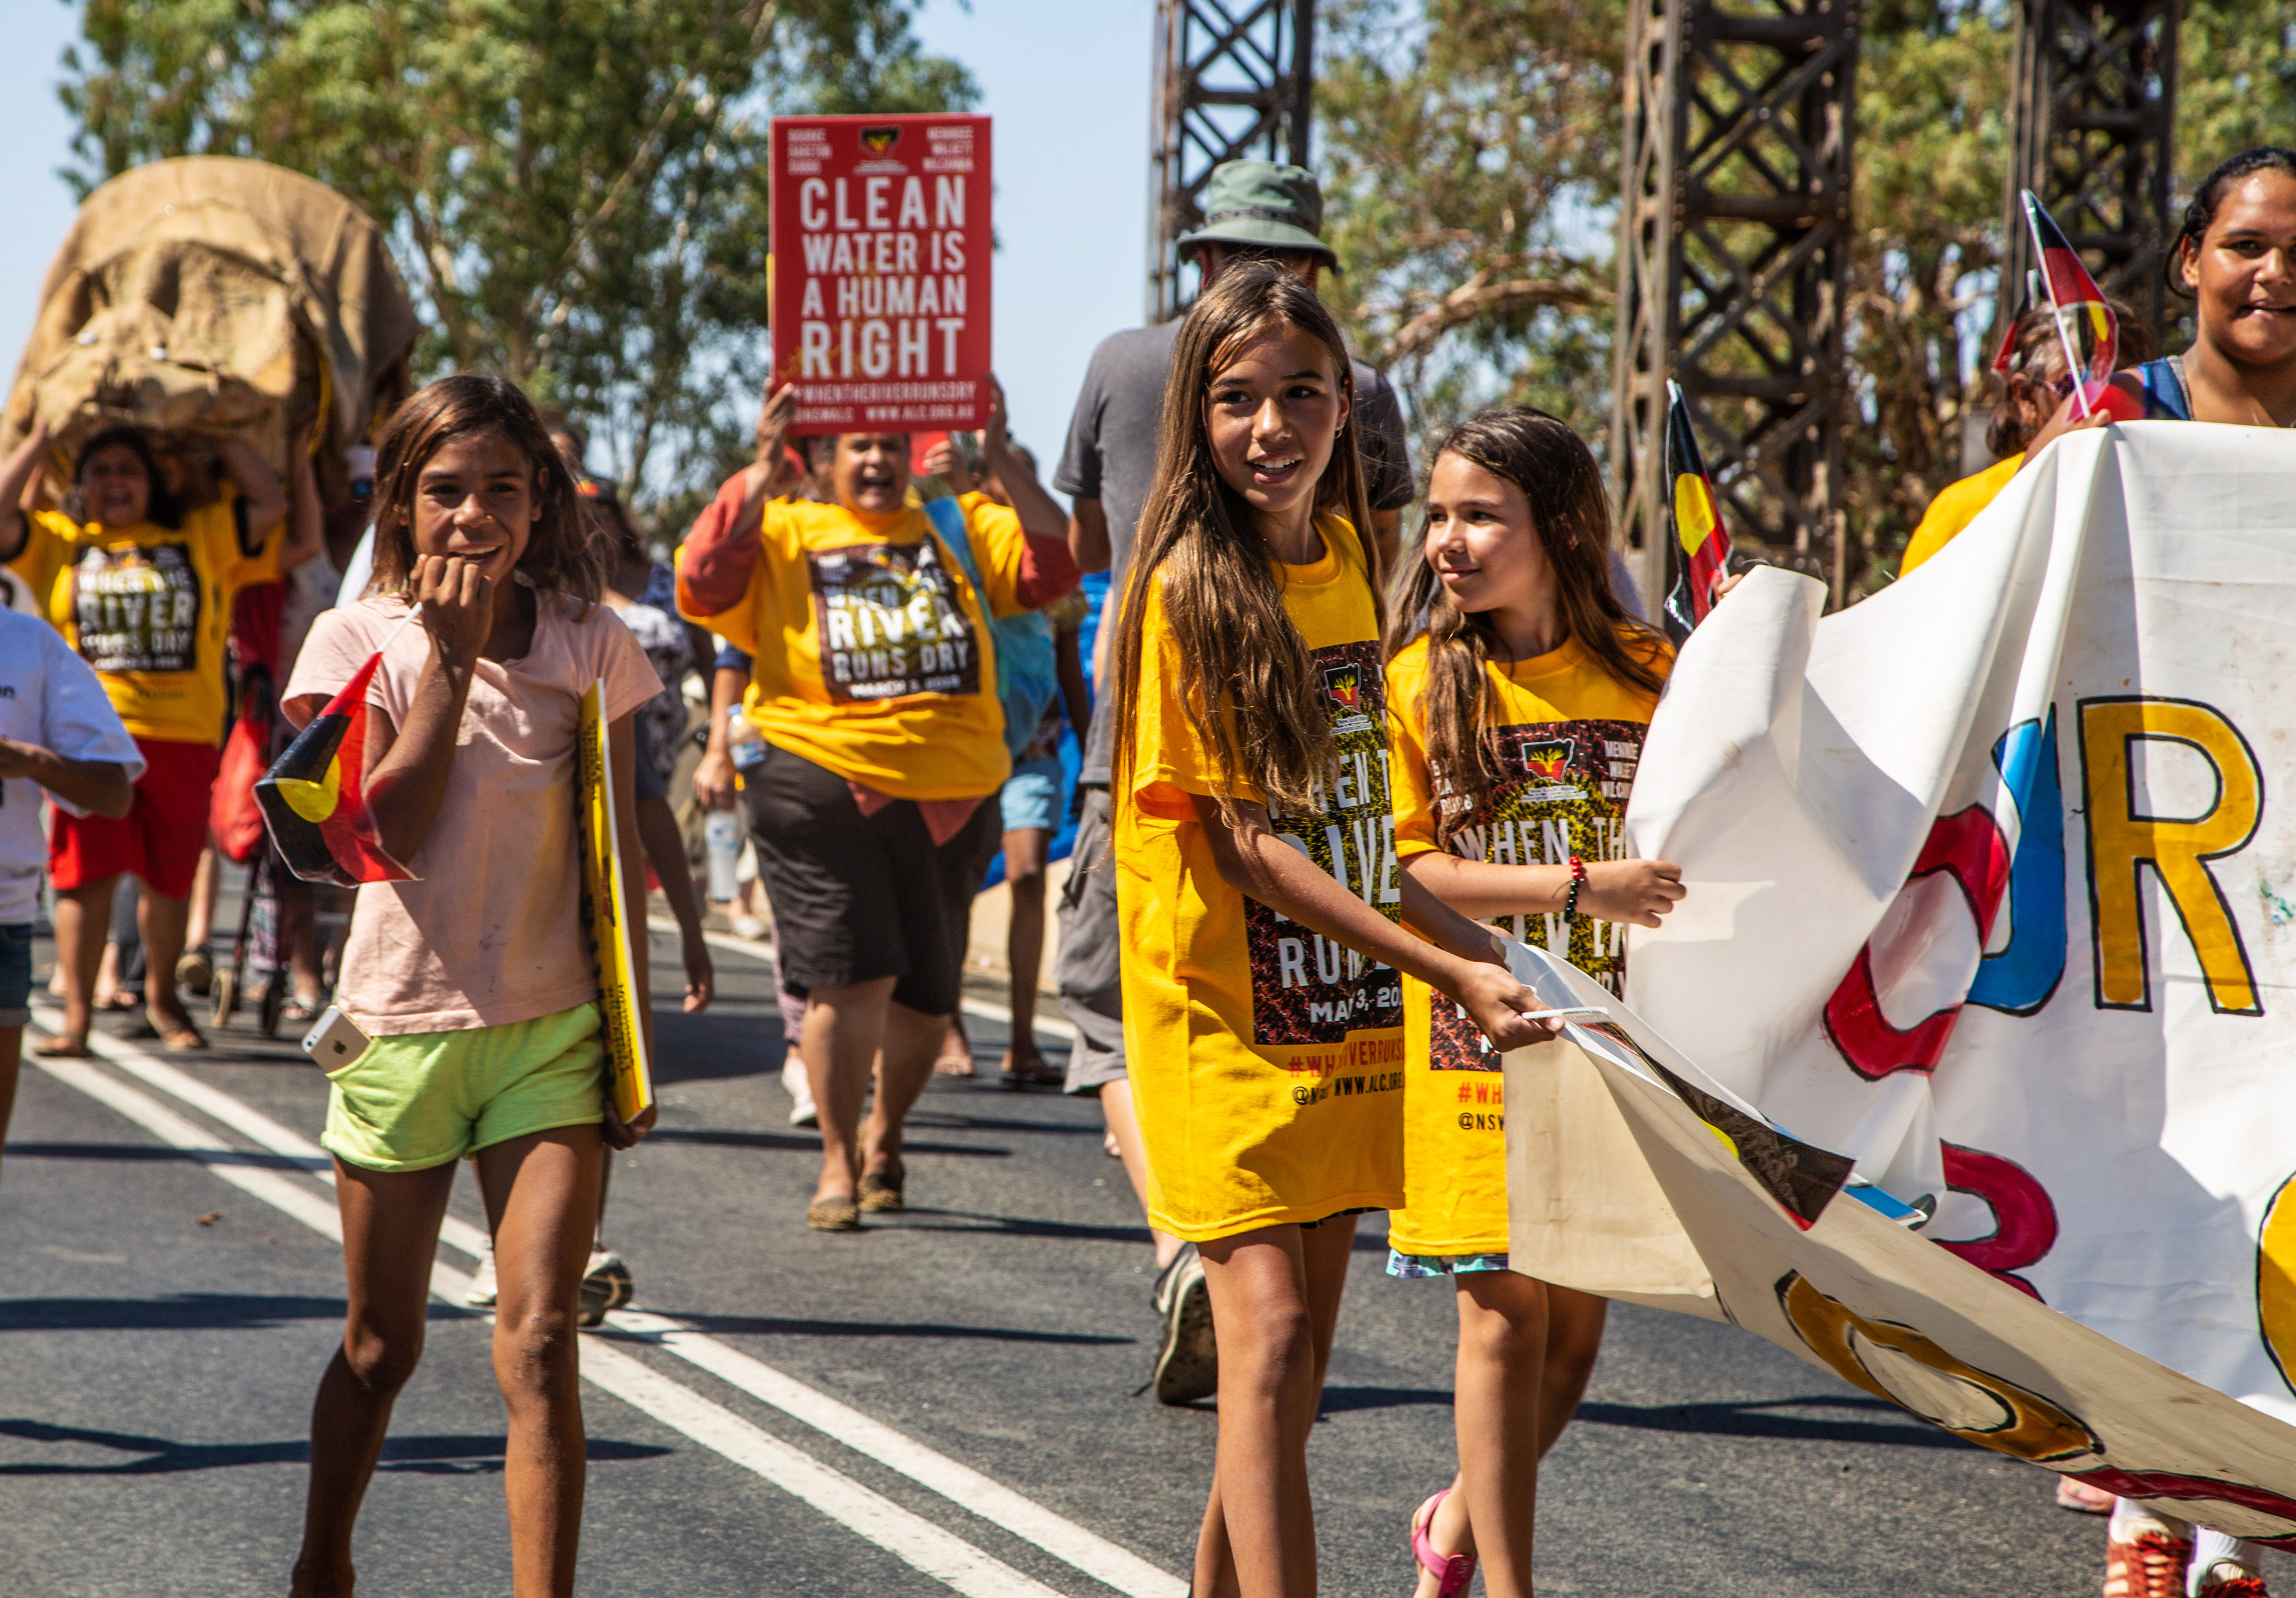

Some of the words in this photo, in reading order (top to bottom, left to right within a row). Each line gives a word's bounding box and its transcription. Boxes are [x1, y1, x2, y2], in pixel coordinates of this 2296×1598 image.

[799, 175, 966, 230] CLEAN
[801, 231, 919, 275] WATER
[931, 230, 966, 274] IS
[801, 277, 825, 318] A
[837, 274, 968, 318] HUMAN
[800, 318, 966, 379] RIGHT
[77, 591, 196, 632] RIVER
[826, 593, 965, 651] RIVER
[832, 647, 907, 683] RUNS
[920, 640, 969, 673] DRY
[1451, 818, 1571, 866] WHEN
[1355, 988, 1369, 1011] 3,
